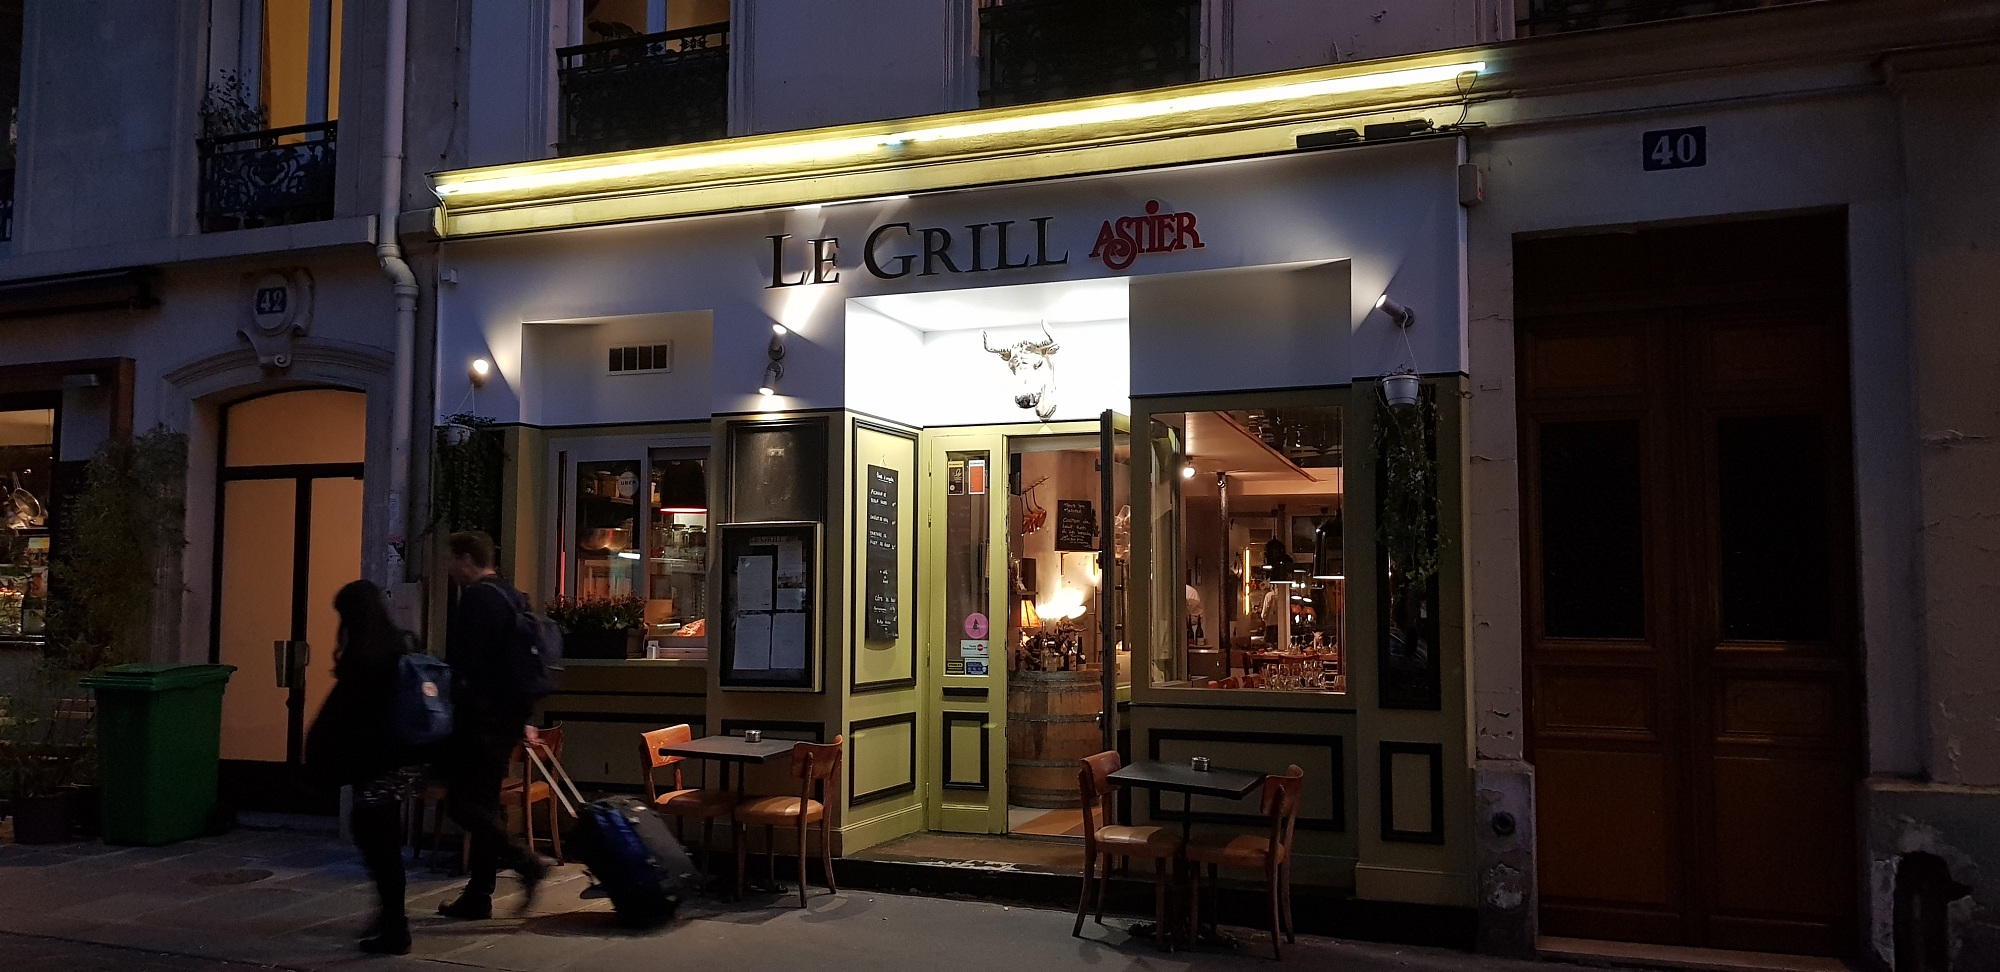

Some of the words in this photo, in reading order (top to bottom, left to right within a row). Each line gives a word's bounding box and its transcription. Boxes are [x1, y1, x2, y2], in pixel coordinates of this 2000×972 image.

[1651, 133, 1697, 165] 40
[764, 233, 840, 290] LE
[863, 216, 1070, 280] GRILL
[260, 290, 282, 311] 42
